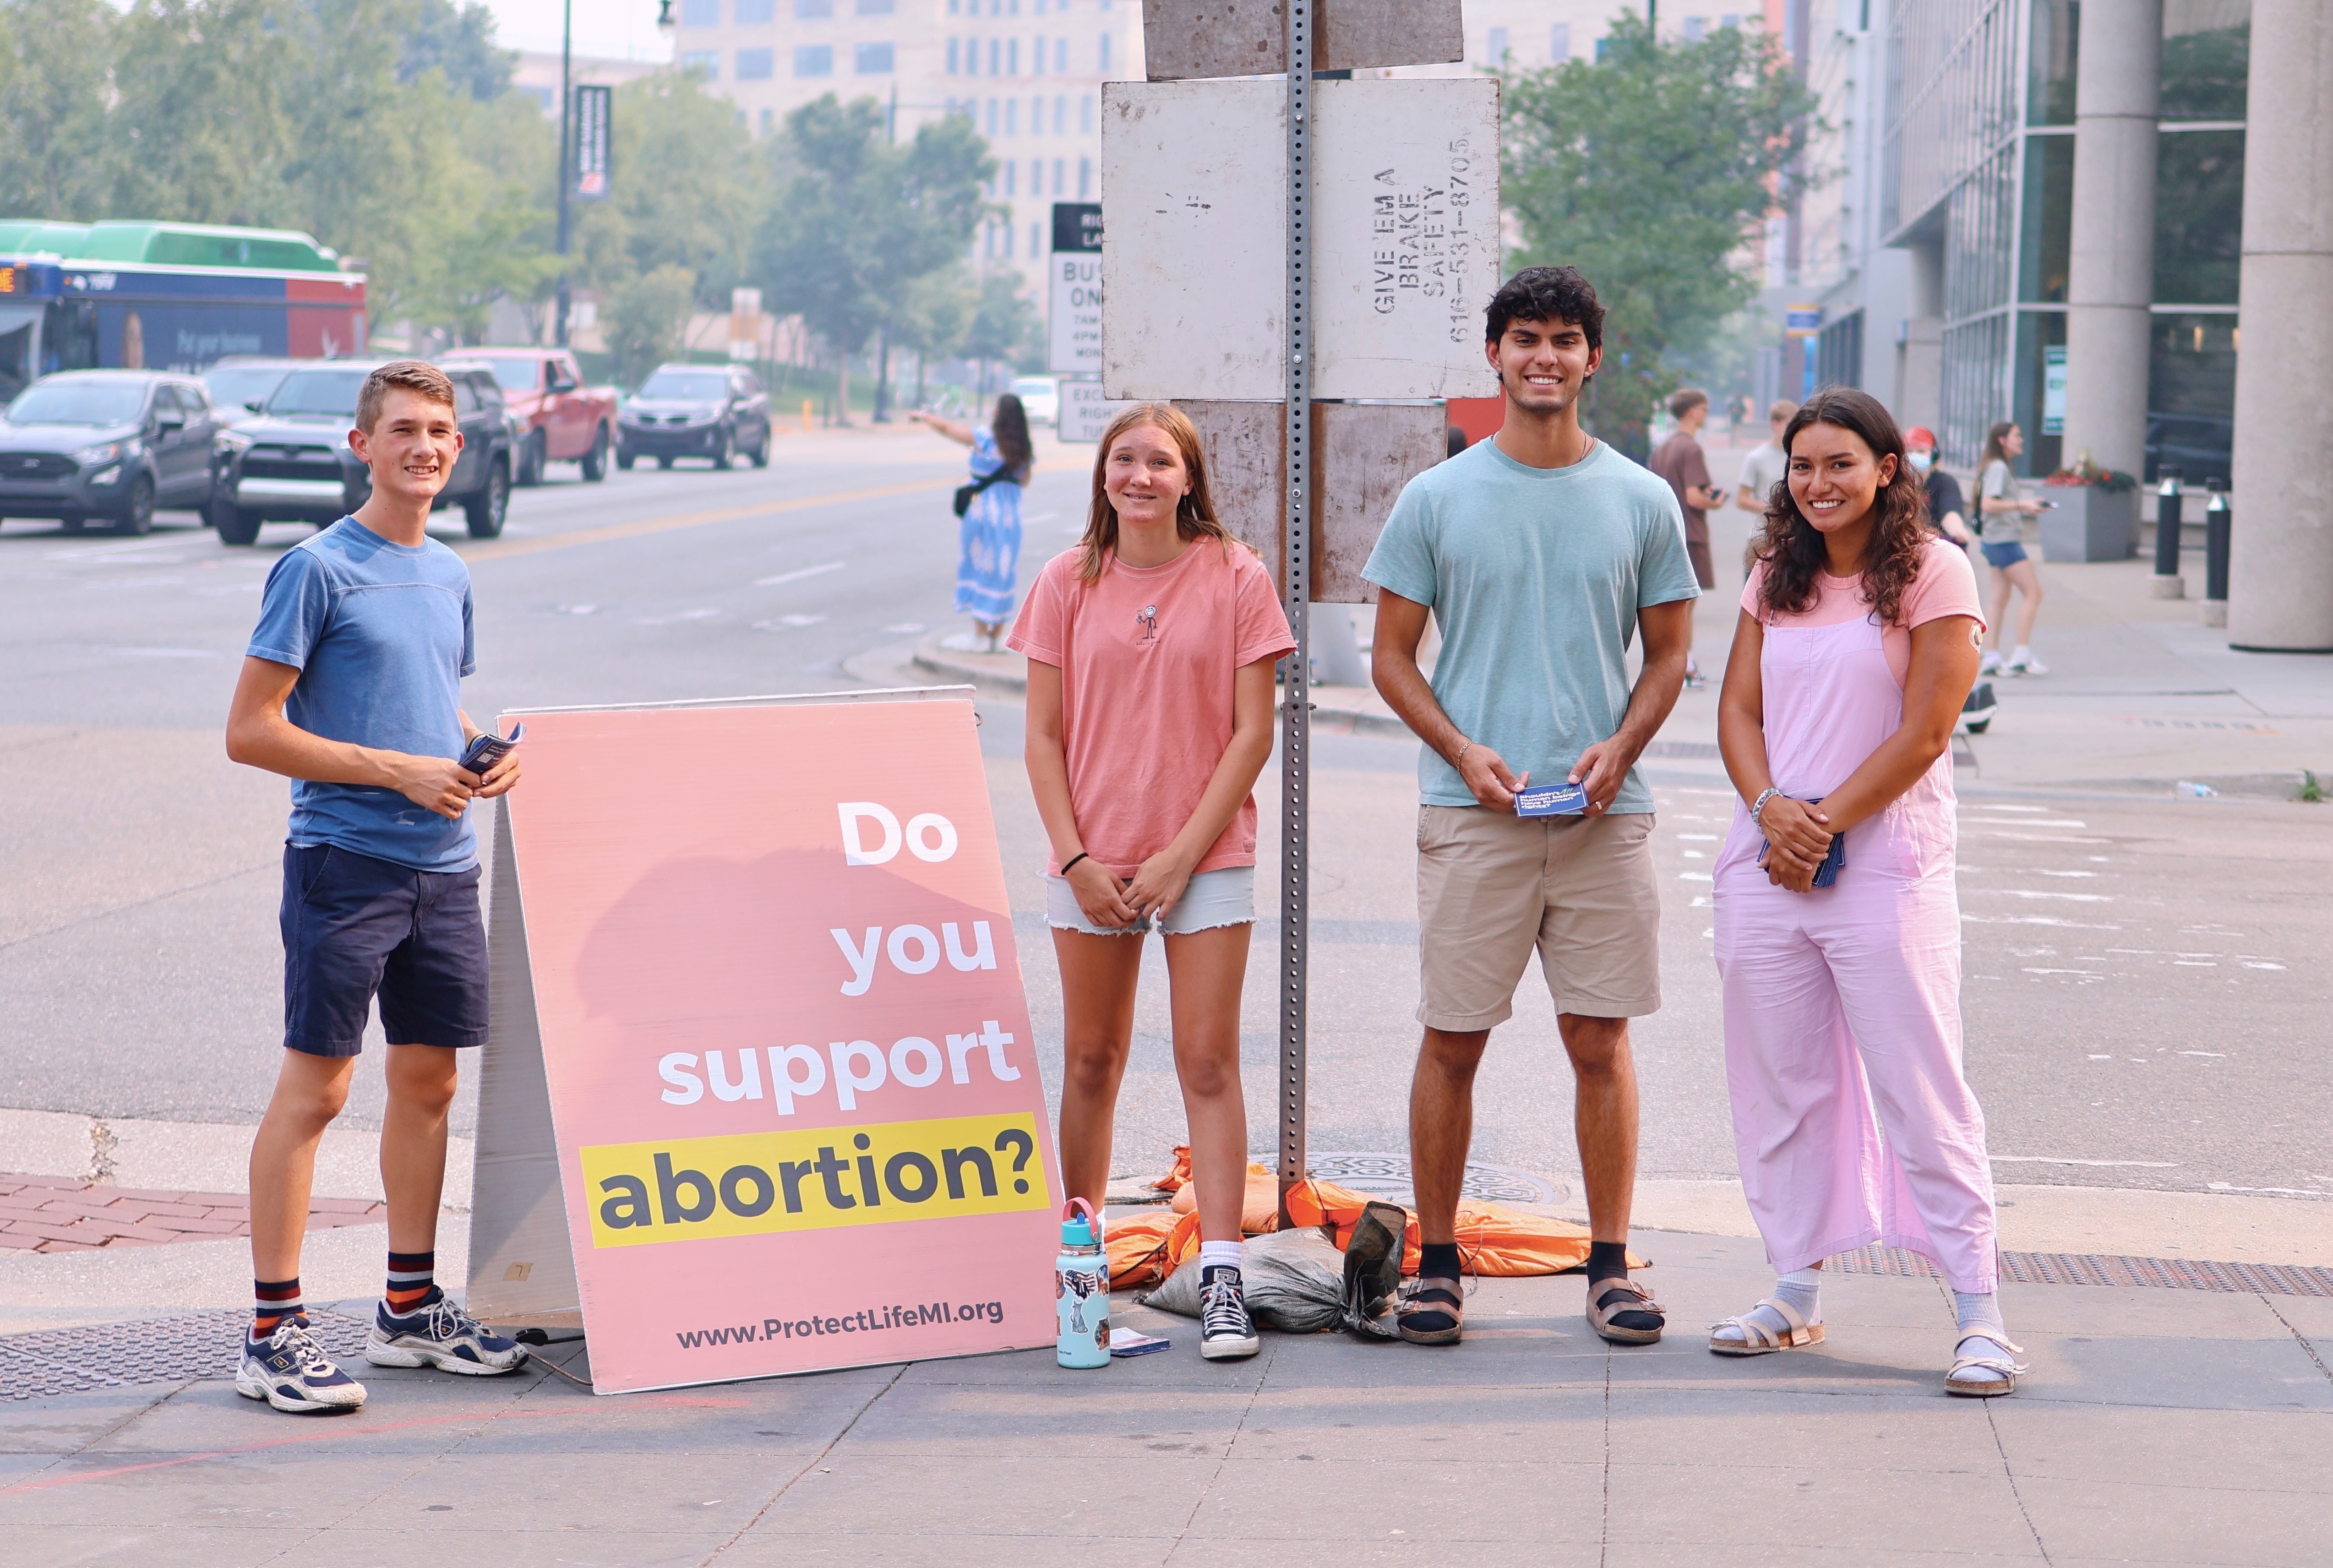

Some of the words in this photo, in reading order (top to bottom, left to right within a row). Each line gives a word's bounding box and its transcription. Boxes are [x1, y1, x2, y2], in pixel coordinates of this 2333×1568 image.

[1374, 169, 1394, 185] A
[1374, 250, 1395, 314] GIVE
[1399, 193, 1419, 289] BRAKE
[1423, 185, 1444, 297] SAFETY
[1449, 139, 1470, 343] 616-531-8705
[838, 802, 958, 866] Do
[829, 920, 998, 996] you
[659, 1019, 1021, 1116] support
[599, 1128, 1034, 1229] abortion?
[676, 1301, 1003, 1349] www.ProtectLifeMI.org
